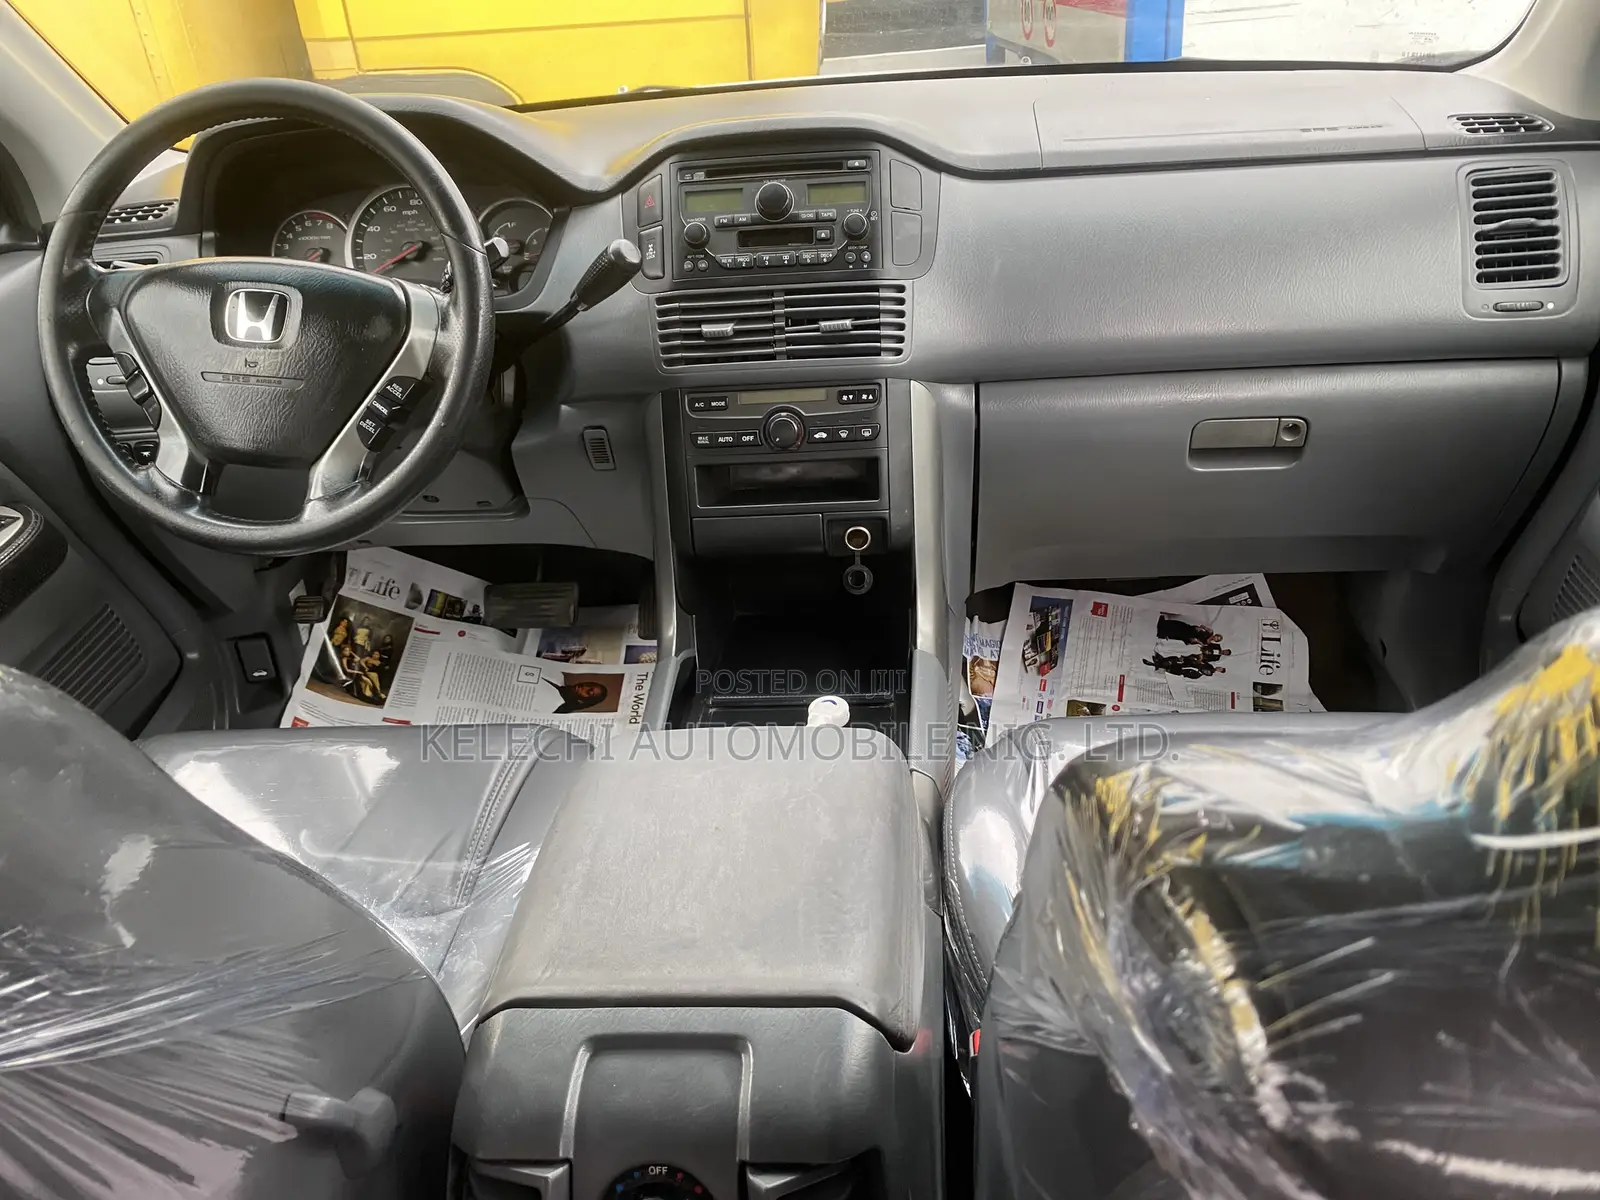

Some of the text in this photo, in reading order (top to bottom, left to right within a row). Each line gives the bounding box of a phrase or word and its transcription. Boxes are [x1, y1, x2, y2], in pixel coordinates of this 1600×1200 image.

[409, 198, 423, 206] 80
[316, 219, 323, 227] 7
[326, 222, 334, 230] 8
[366, 225, 381, 233] 40
[363, 252, 377, 260] 20
[221, 374, 251, 384] SRS
[385, 385, 403, 399] ACCEL
[391, 382, 403, 393] RES
[372, 400, 389, 416] CANCEL
[359, 420, 375, 434] DECEL
[364, 418, 376, 427] SET
[741, 434, 755, 442] OFF
[361, 571, 401, 600] Life
[1258, 633, 1282, 676] Life
[628, 671, 649, 725] The World
[648, 1166, 668, 1175] OFF
